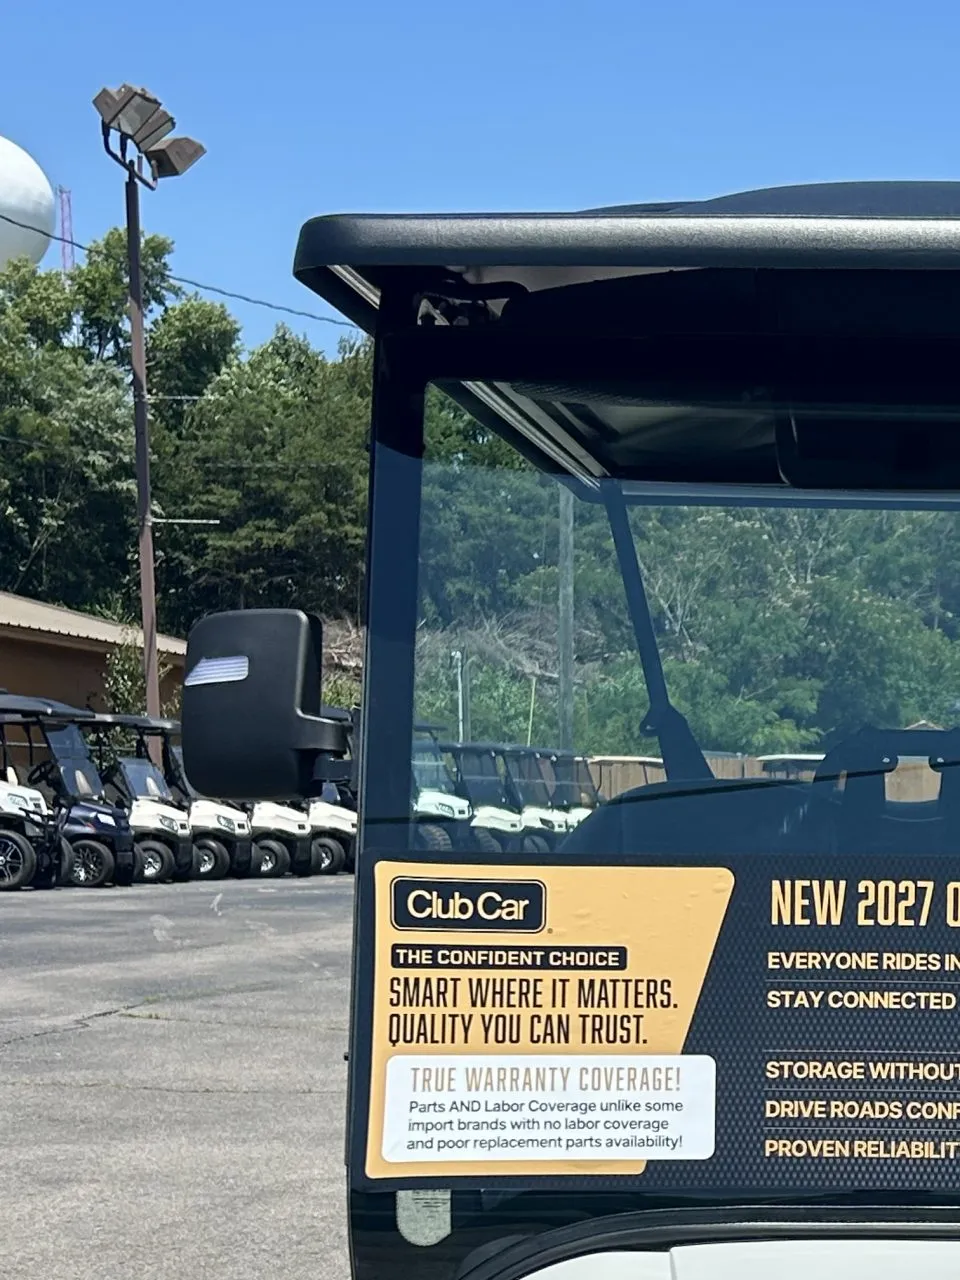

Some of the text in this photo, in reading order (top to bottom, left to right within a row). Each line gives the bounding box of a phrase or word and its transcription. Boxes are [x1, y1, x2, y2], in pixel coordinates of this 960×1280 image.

[407, 890, 529, 920] Club Car
[771, 880, 846, 926] NEW
[858, 881, 934, 926] 2027
[396, 949, 619, 966] THE CONFIDENT CHOICE
[768, 952, 878, 970] EVERYONE
[883, 954, 941, 971] RIDES
[390, 977, 678, 1009] SMART WHERE IT MATTERS.
[767, 991, 824, 1008] STAY
[828, 992, 956, 1009] CONNECTED
[389, 1014, 647, 1047] QUALITY YOU CAN TRUST.
[766, 1061, 864, 1079] STORAGE
[411, 1068, 681, 1092] TRUE WARRANTY COVERAGE!
[409, 1100, 682, 1115] Parts AND Labor Coverage unlike some
[765, 1101, 826, 1118] DRIVE
[830, 1101, 902, 1119] ROADS
[408, 1118, 668, 1134] import brands with no labor coverage
[407, 1135, 682, 1151] and poor replacement parts availability!
[765, 1140, 850, 1157] PROVEN
